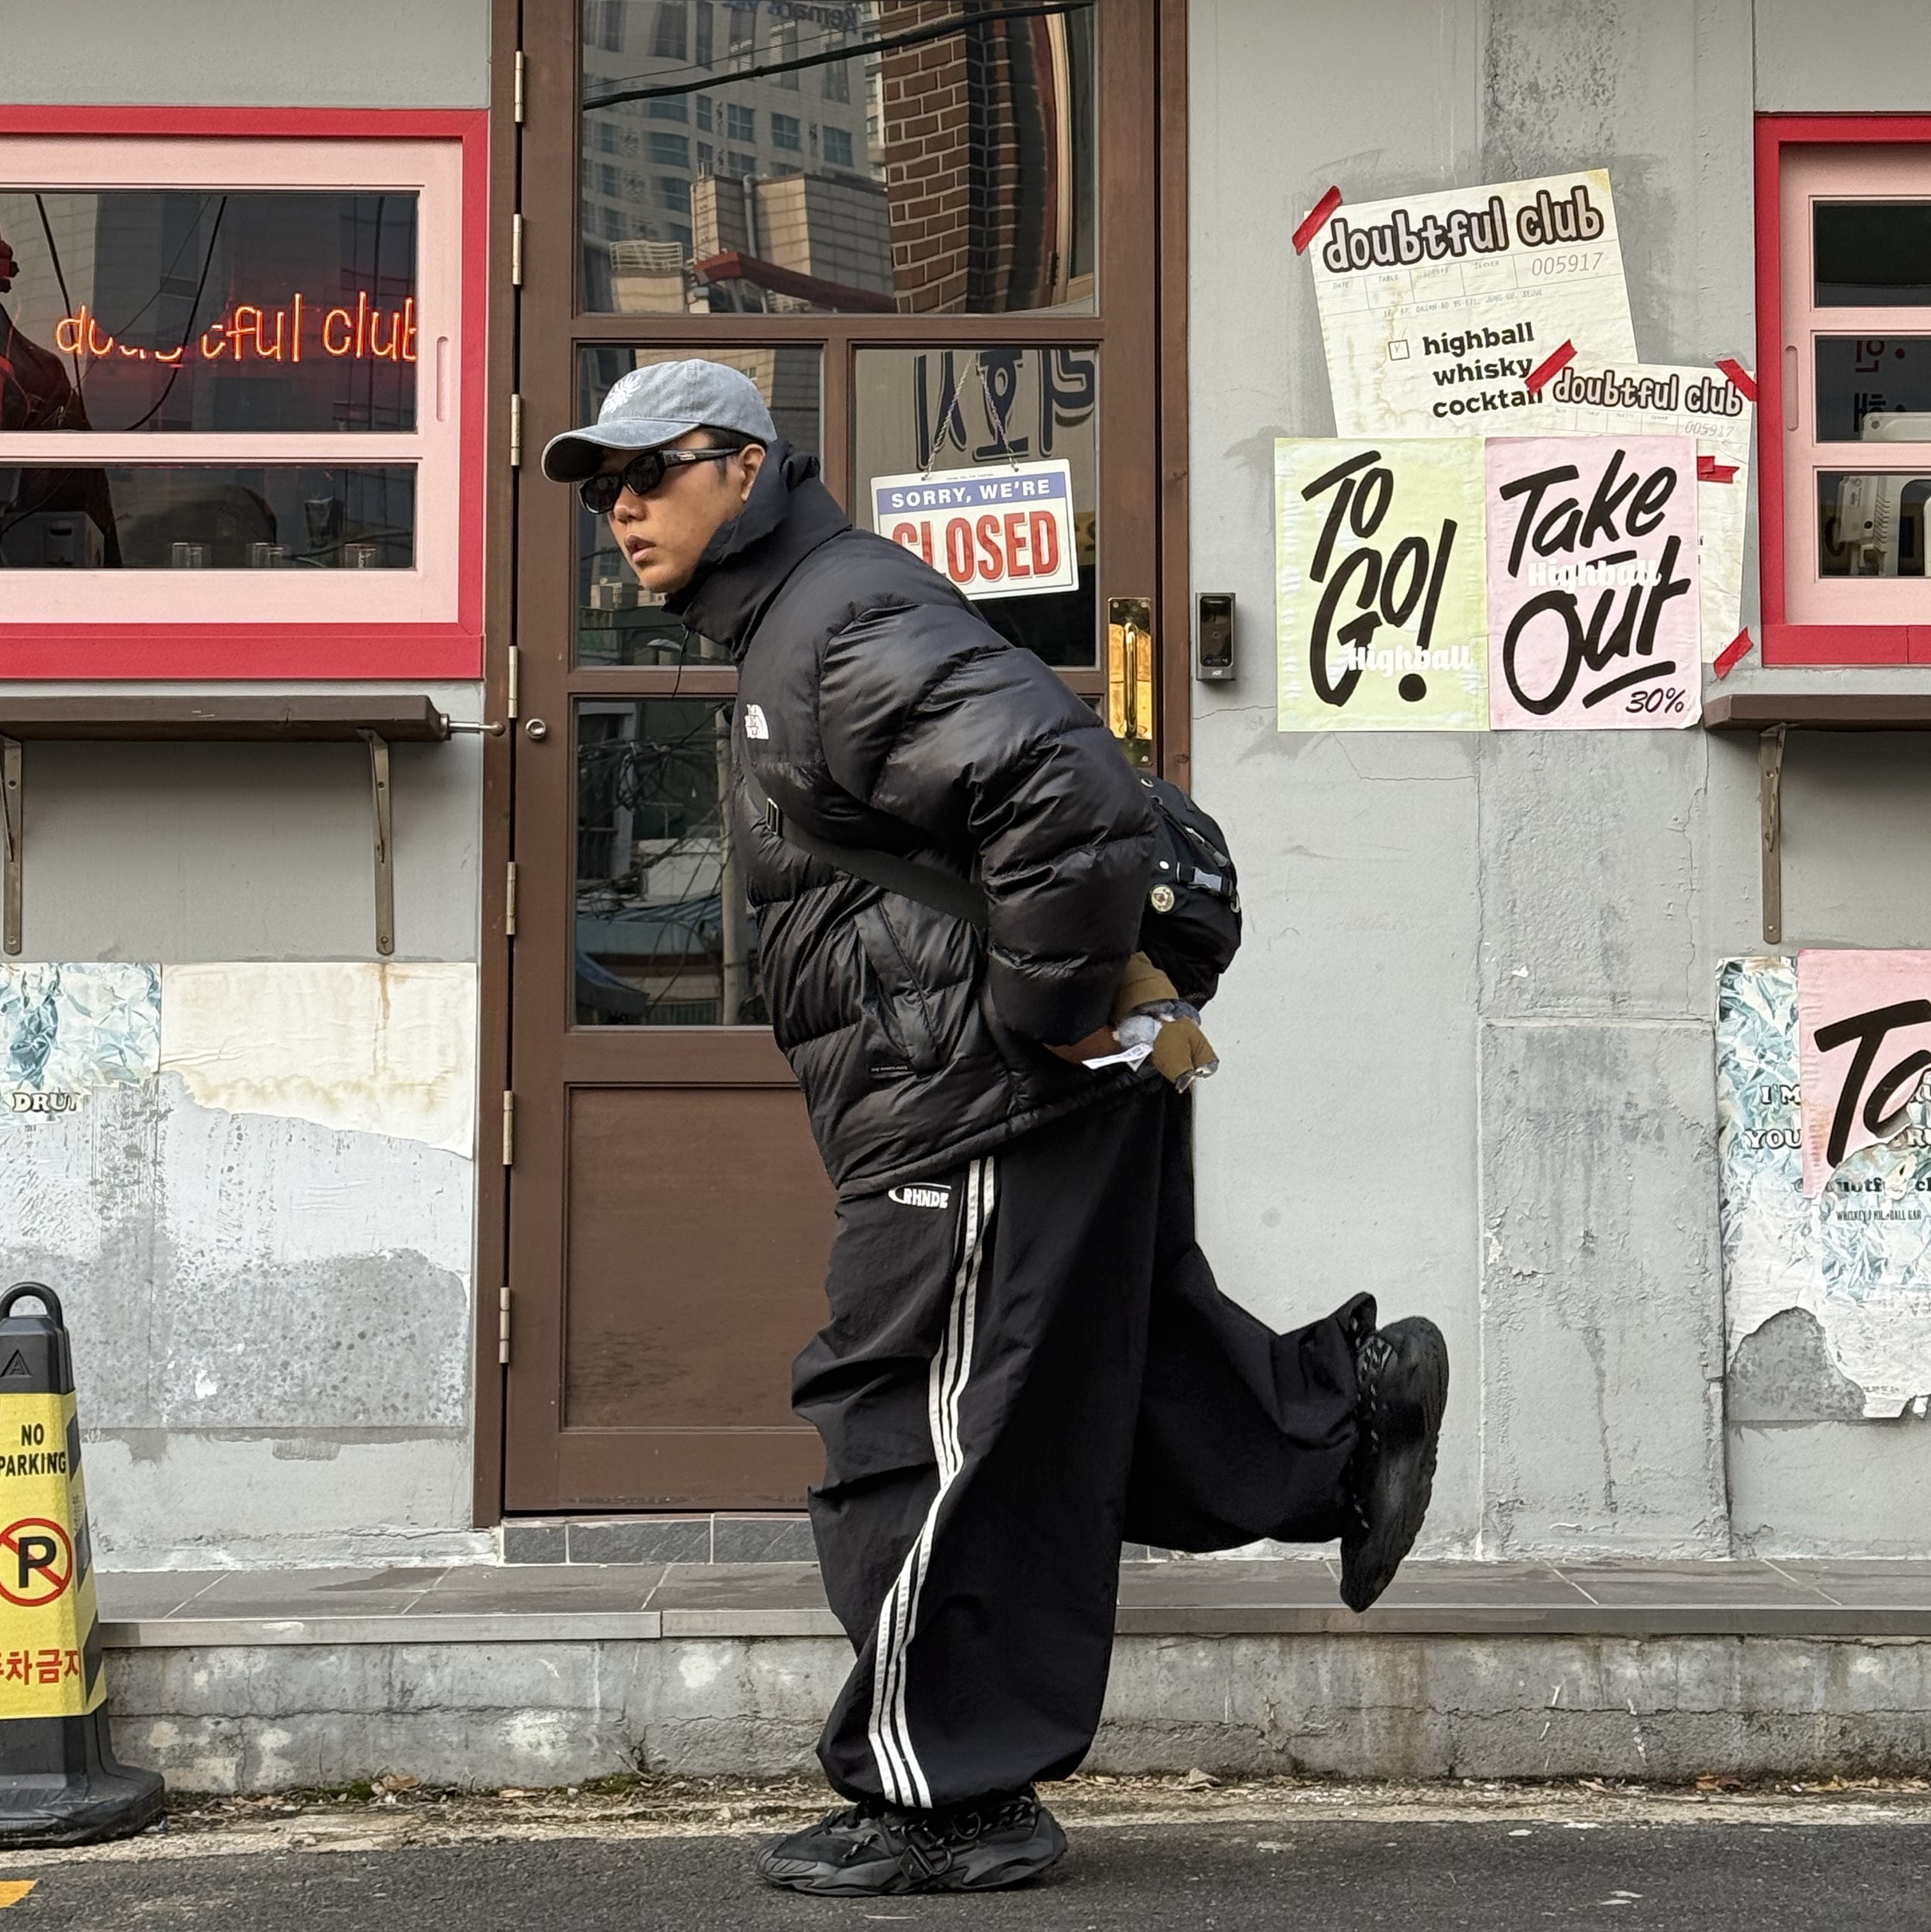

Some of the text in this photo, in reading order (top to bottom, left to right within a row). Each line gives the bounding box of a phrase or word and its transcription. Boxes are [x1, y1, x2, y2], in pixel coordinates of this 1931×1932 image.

[1324, 185, 1605, 273] doubtful club
[1532, 252, 1604, 276] 005917
[1423, 322, 1534, 357] highball
[1433, 357, 1532, 386] whisky
[1553, 367, 1743, 416] doubtful club
[891, 479, 1050, 509] SORRY, WE'RE
[1499, 448, 1677, 578] Take
[1528, 560, 1662, 594] Highball
[1503, 535, 1691, 715] Out
[1348, 645, 1473, 677] Highball
[1625, 688, 1684, 714] 30%
[22, 1423, 44, 1446] NO
[0, 1649, 82, 1685] 차금지
